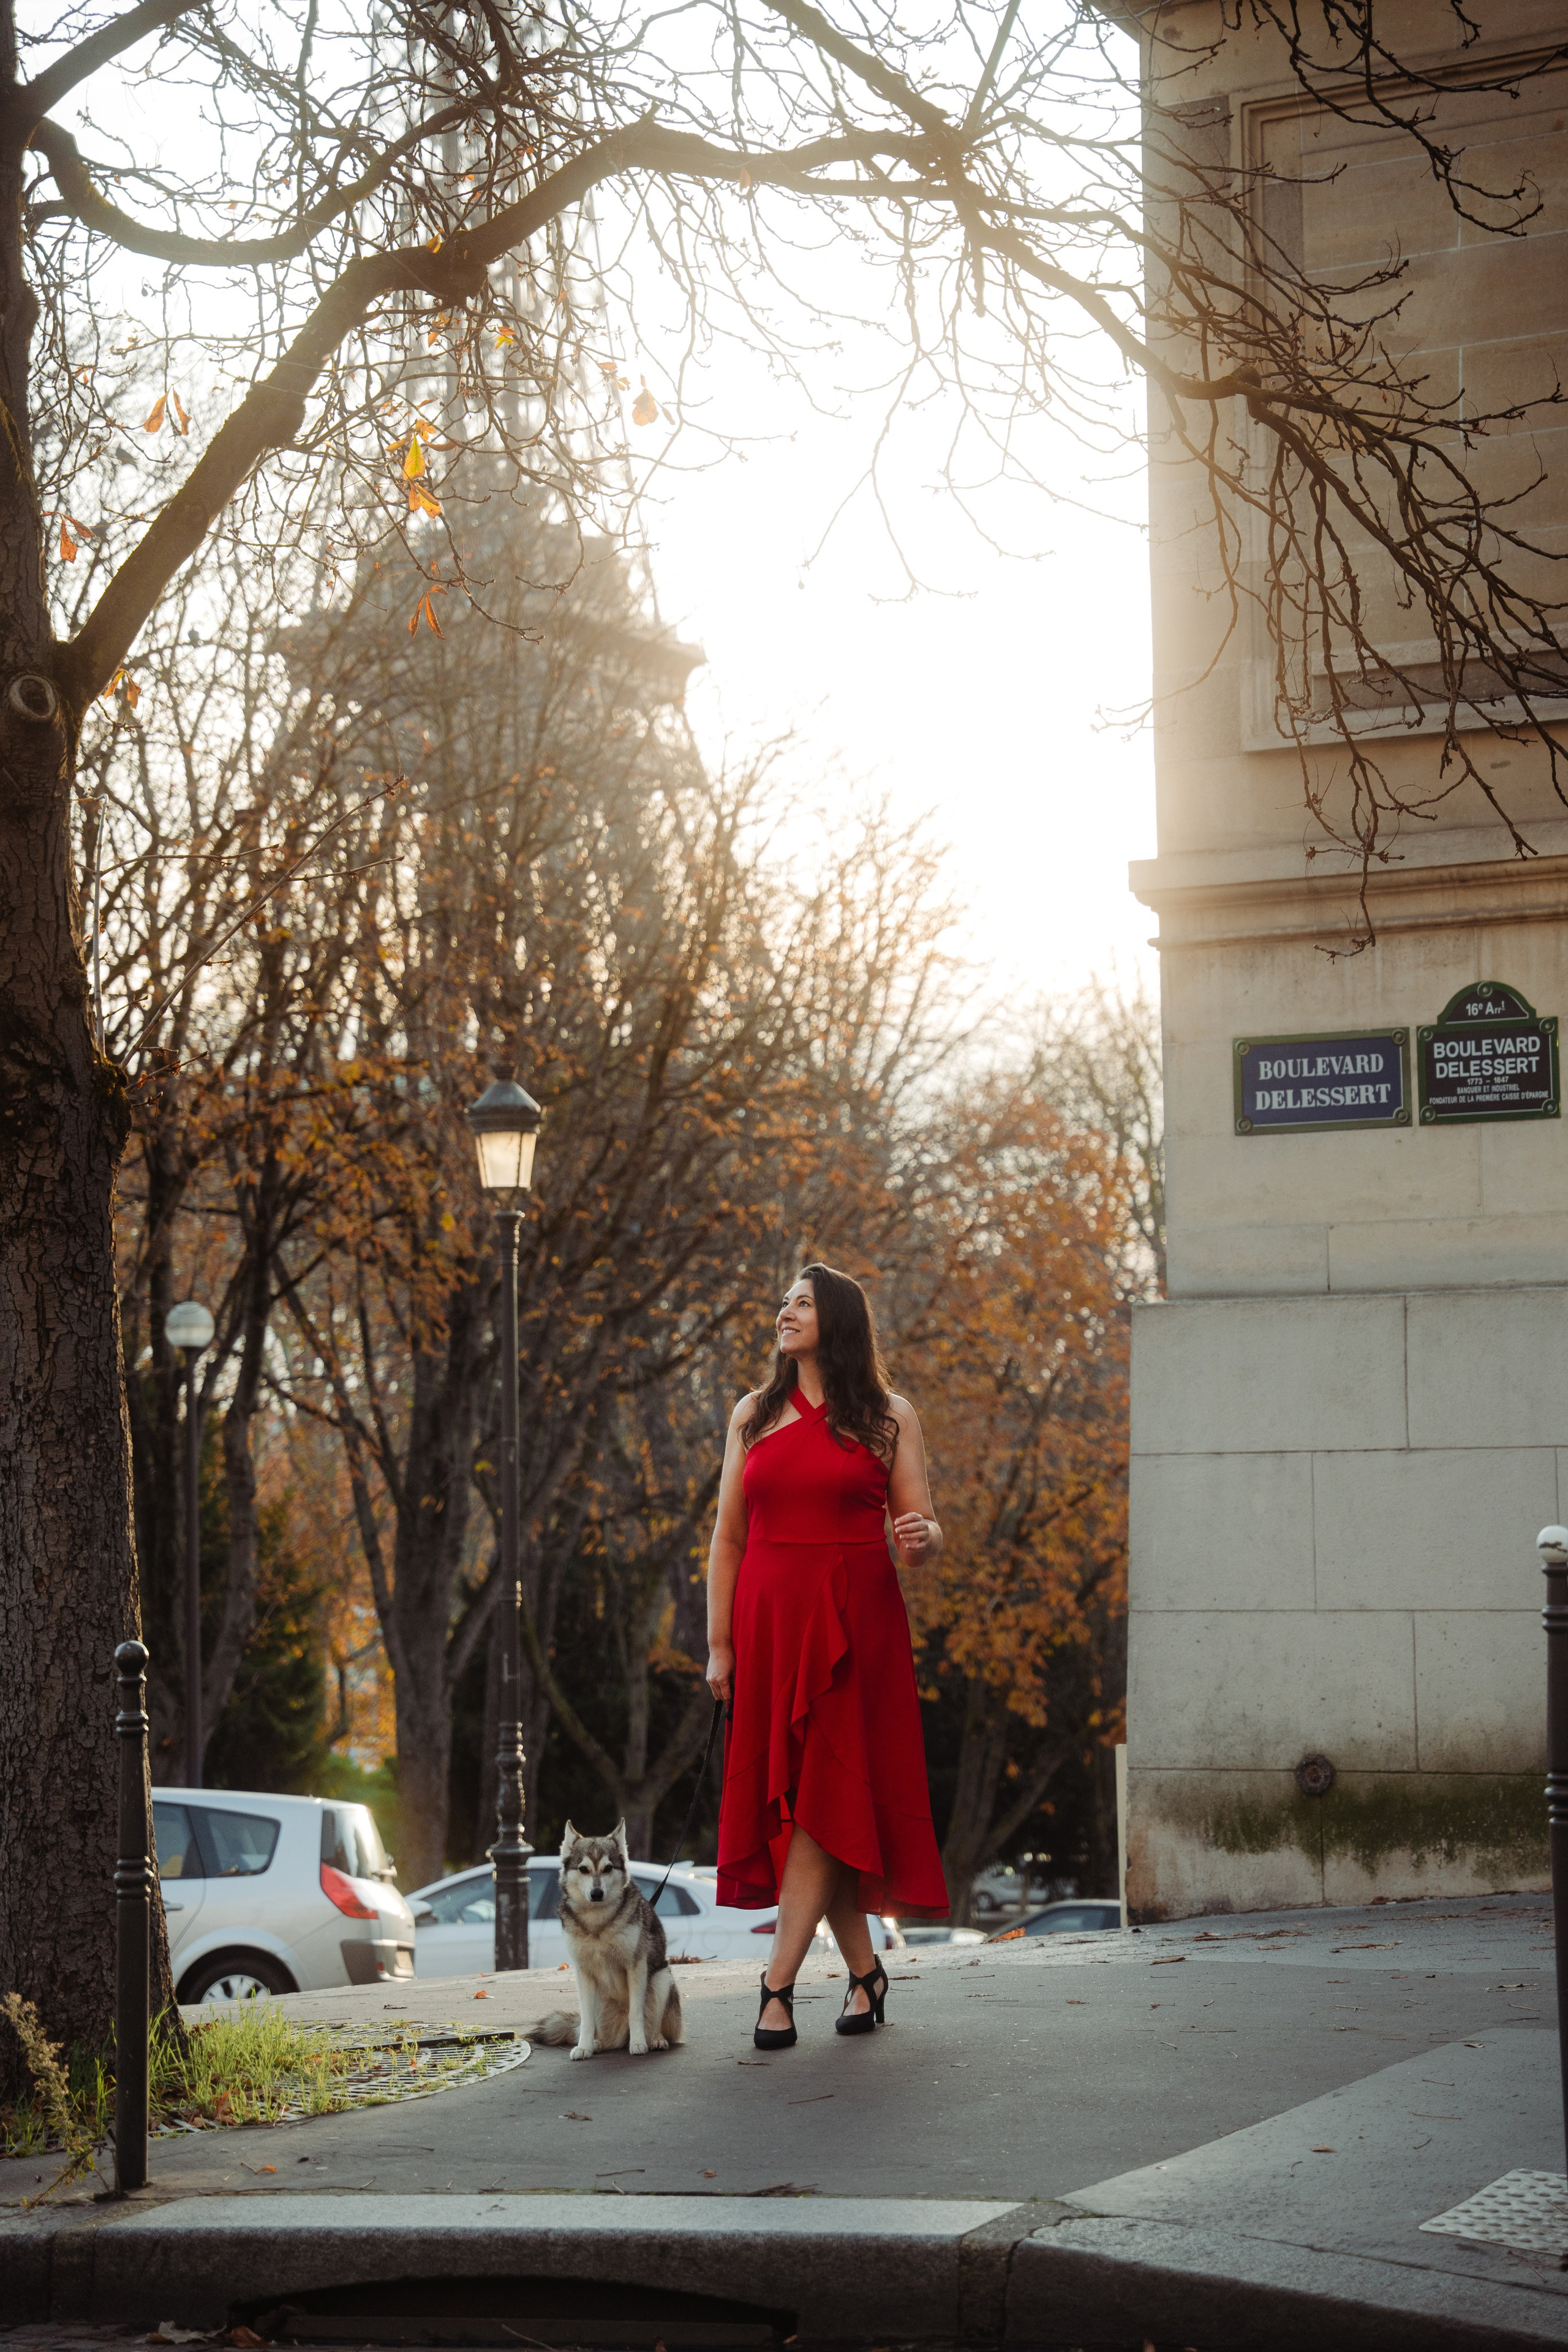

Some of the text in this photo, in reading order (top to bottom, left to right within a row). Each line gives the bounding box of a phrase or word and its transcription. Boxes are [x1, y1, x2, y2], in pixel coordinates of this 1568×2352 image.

[1433, 1036, 1540, 1059] BOULEVARD
[1258, 1053, 1384, 1080] BOULEVARD
[1435, 1056, 1540, 1079] DELESSERT
[1255, 1083, 1391, 1111] DELESSERT
[1429, 1096, 1458, 1105] FONDATEUR
[1501, 1092, 1520, 1101] CAISSE
[1457, 1084, 1520, 1095] BANQUIER ET INDUSTRIEL
